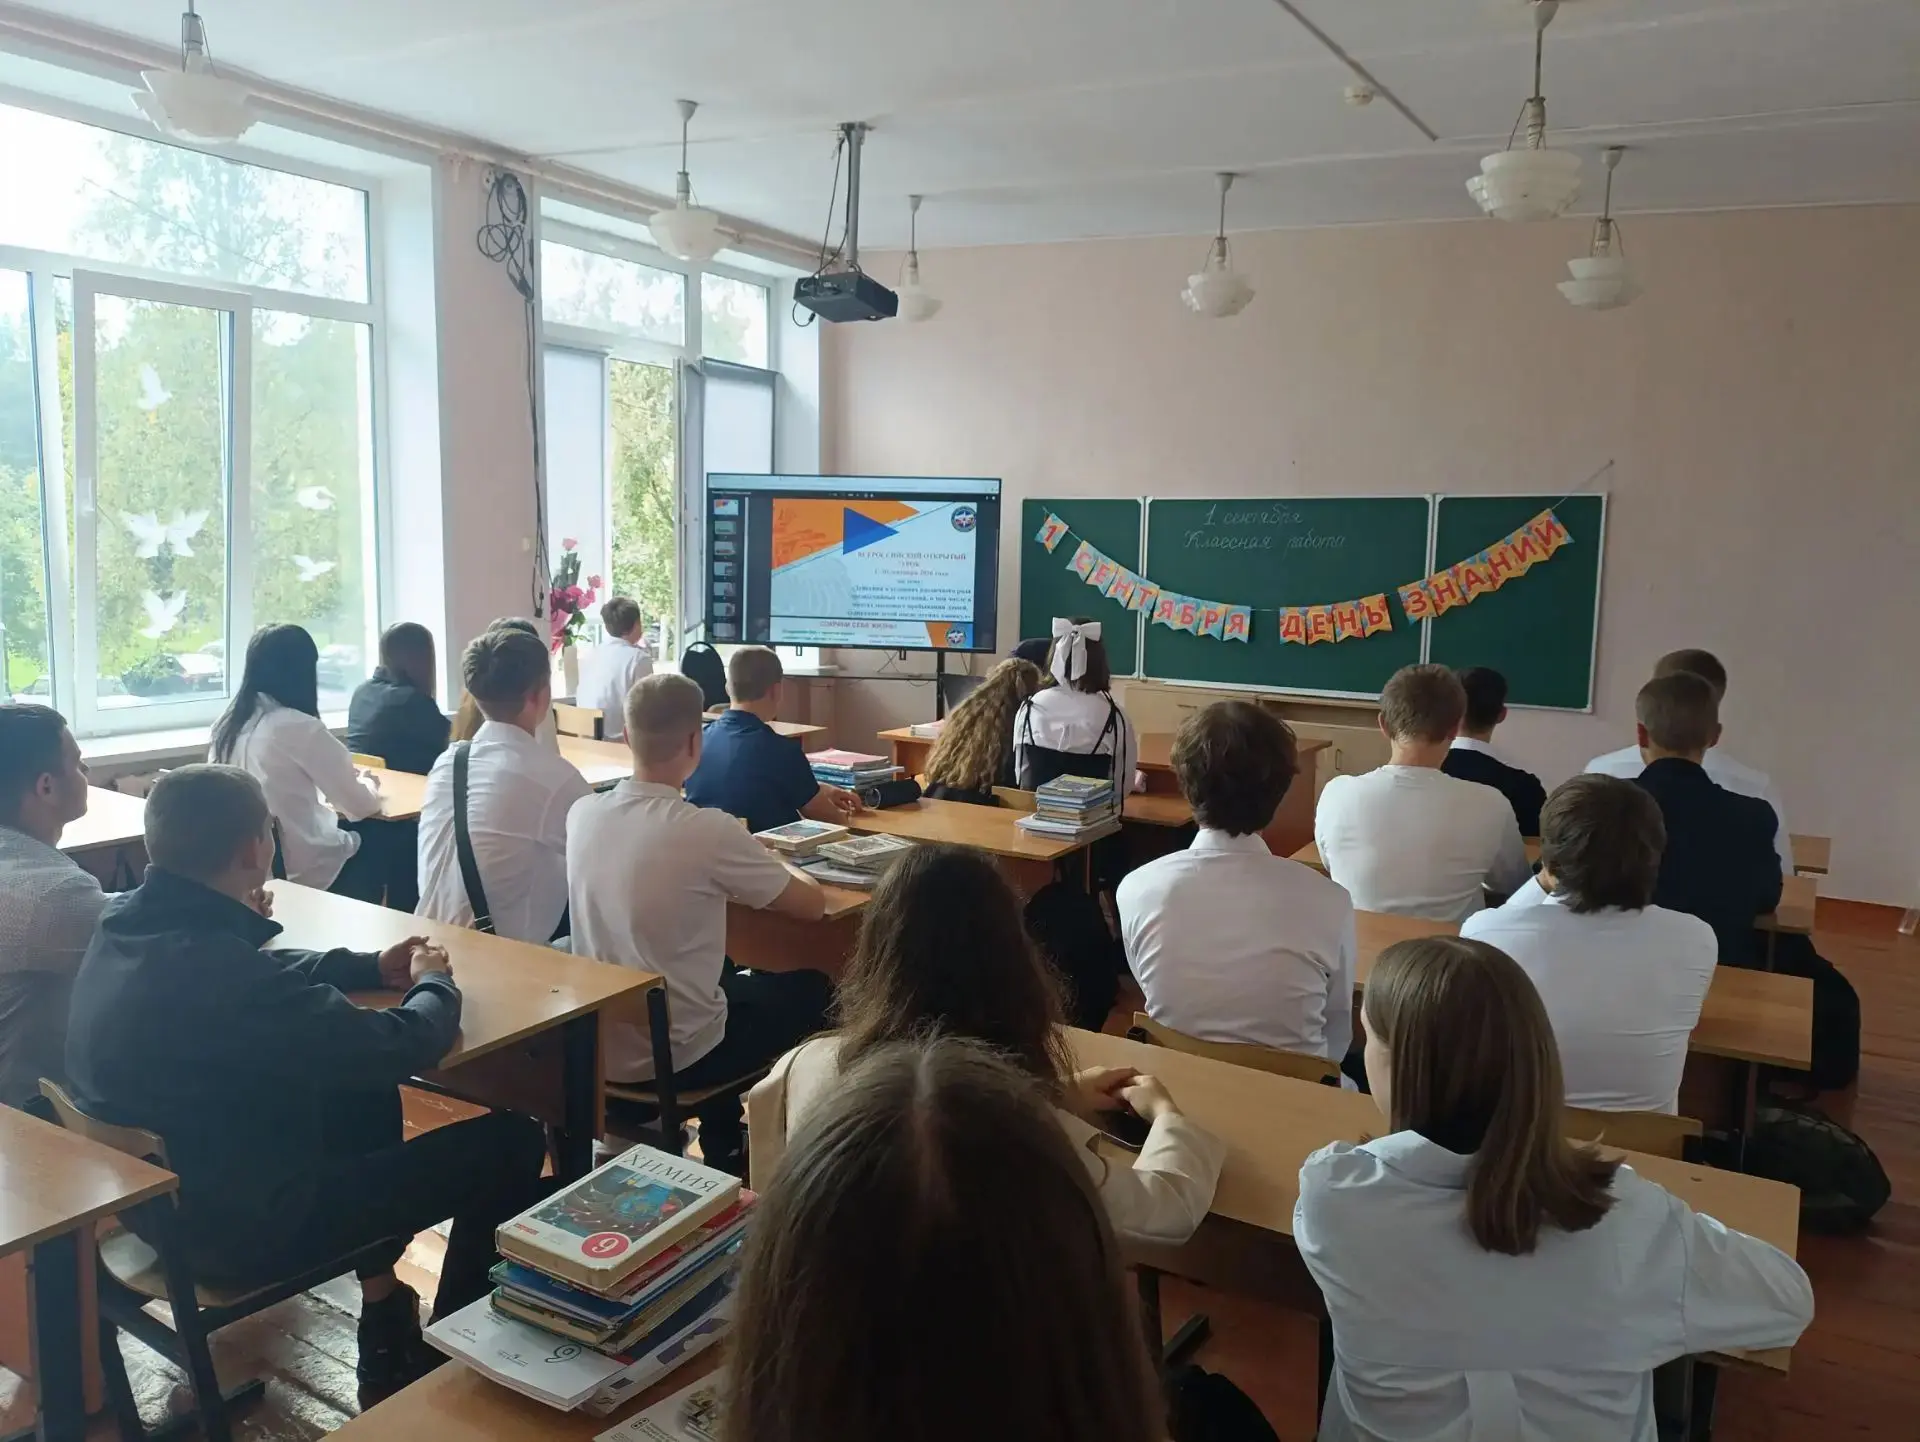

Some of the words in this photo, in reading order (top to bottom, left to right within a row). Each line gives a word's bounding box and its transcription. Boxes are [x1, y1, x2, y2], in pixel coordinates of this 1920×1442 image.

[1203, 503, 1217, 526] 1
[1223, 503, 1304, 527] сентября
[1183, 530, 1273, 551] Классная
[1282, 528, 1346, 560] работа
[1044, 524, 1057, 542] 1
[1075, 552, 1245, 634] СЕНТЯБРЯ
[1282, 606, 1384, 638] ДЕНЬ
[1407, 518, 1563, 614] ЗНАНИЙ
[623, 1154, 720, 1193] ХИМИЯ
[591, 1237, 619, 1253] 9
[544, 1343, 582, 1364] 9
